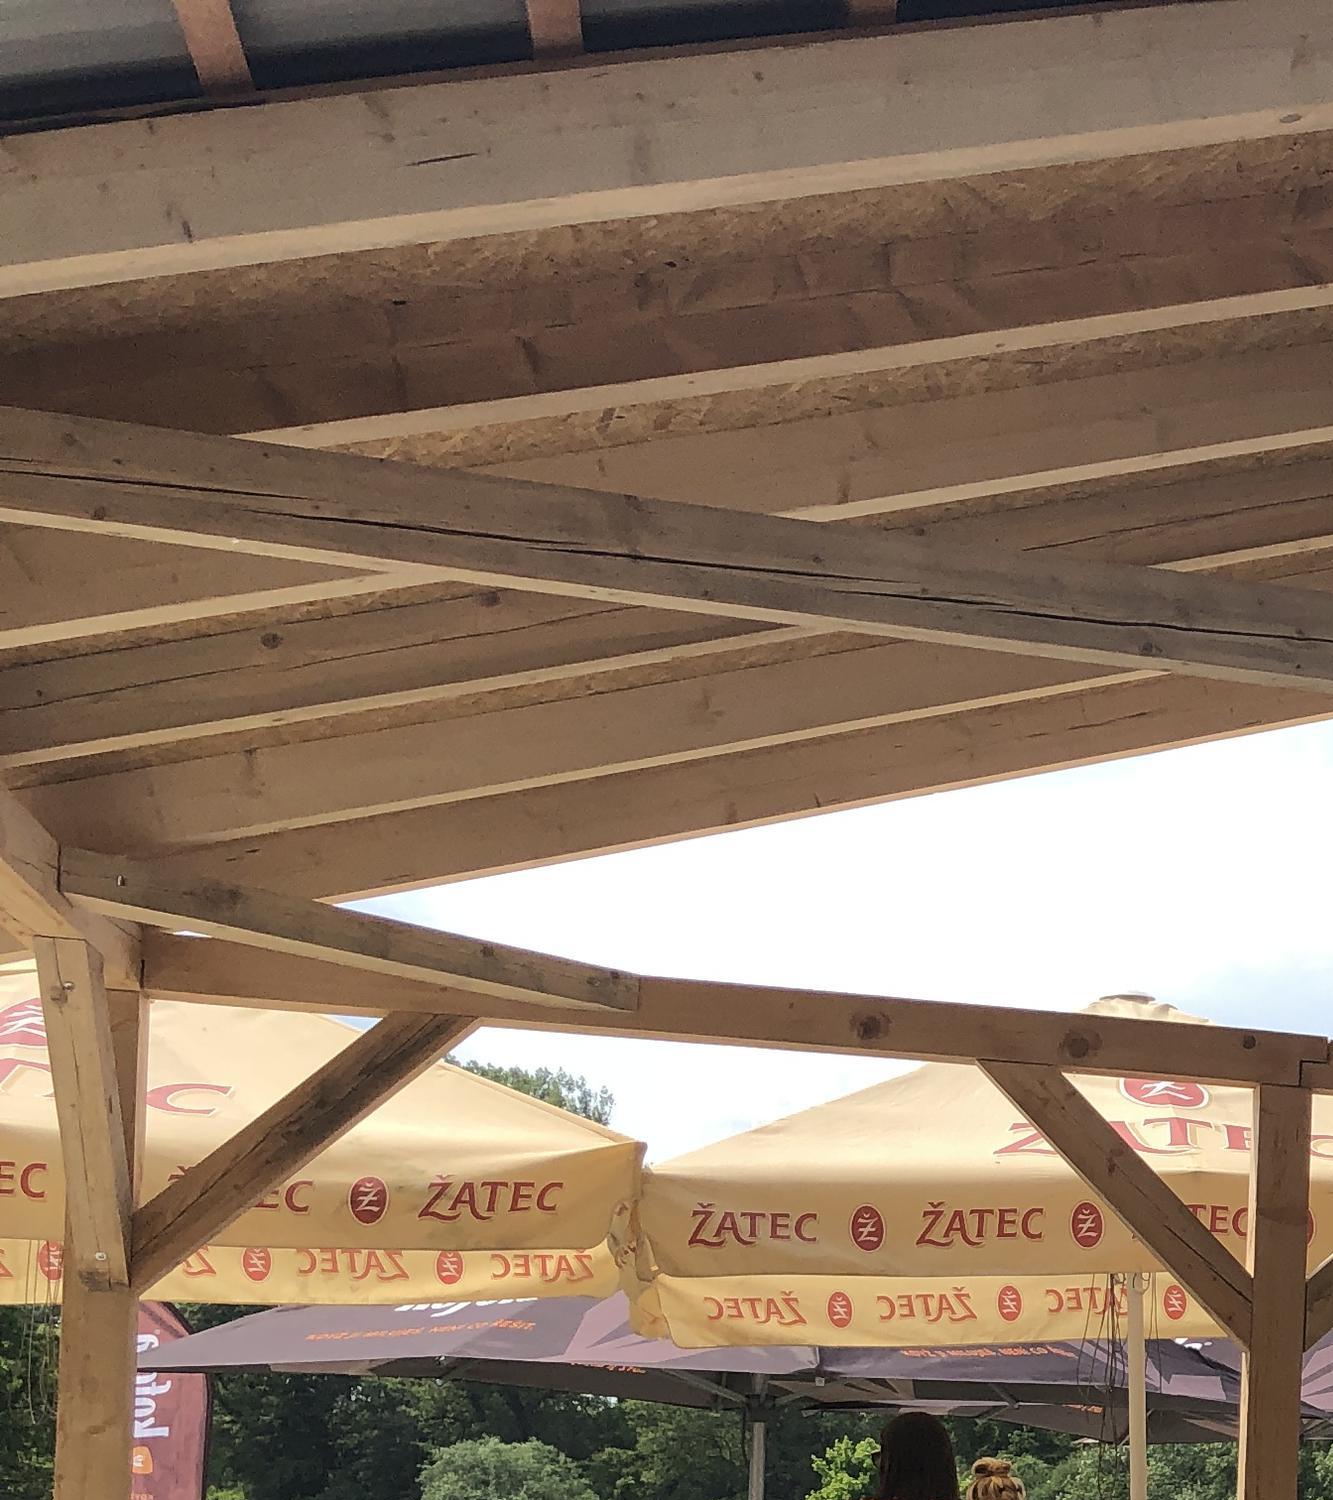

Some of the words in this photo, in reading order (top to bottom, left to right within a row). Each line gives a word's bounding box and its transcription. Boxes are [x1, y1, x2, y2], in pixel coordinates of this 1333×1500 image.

[417, 1174, 564, 1221] ŽATEC
[688, 1202, 818, 1248] ŽATEC
[916, 1201, 1044, 1247] ŽATEC
